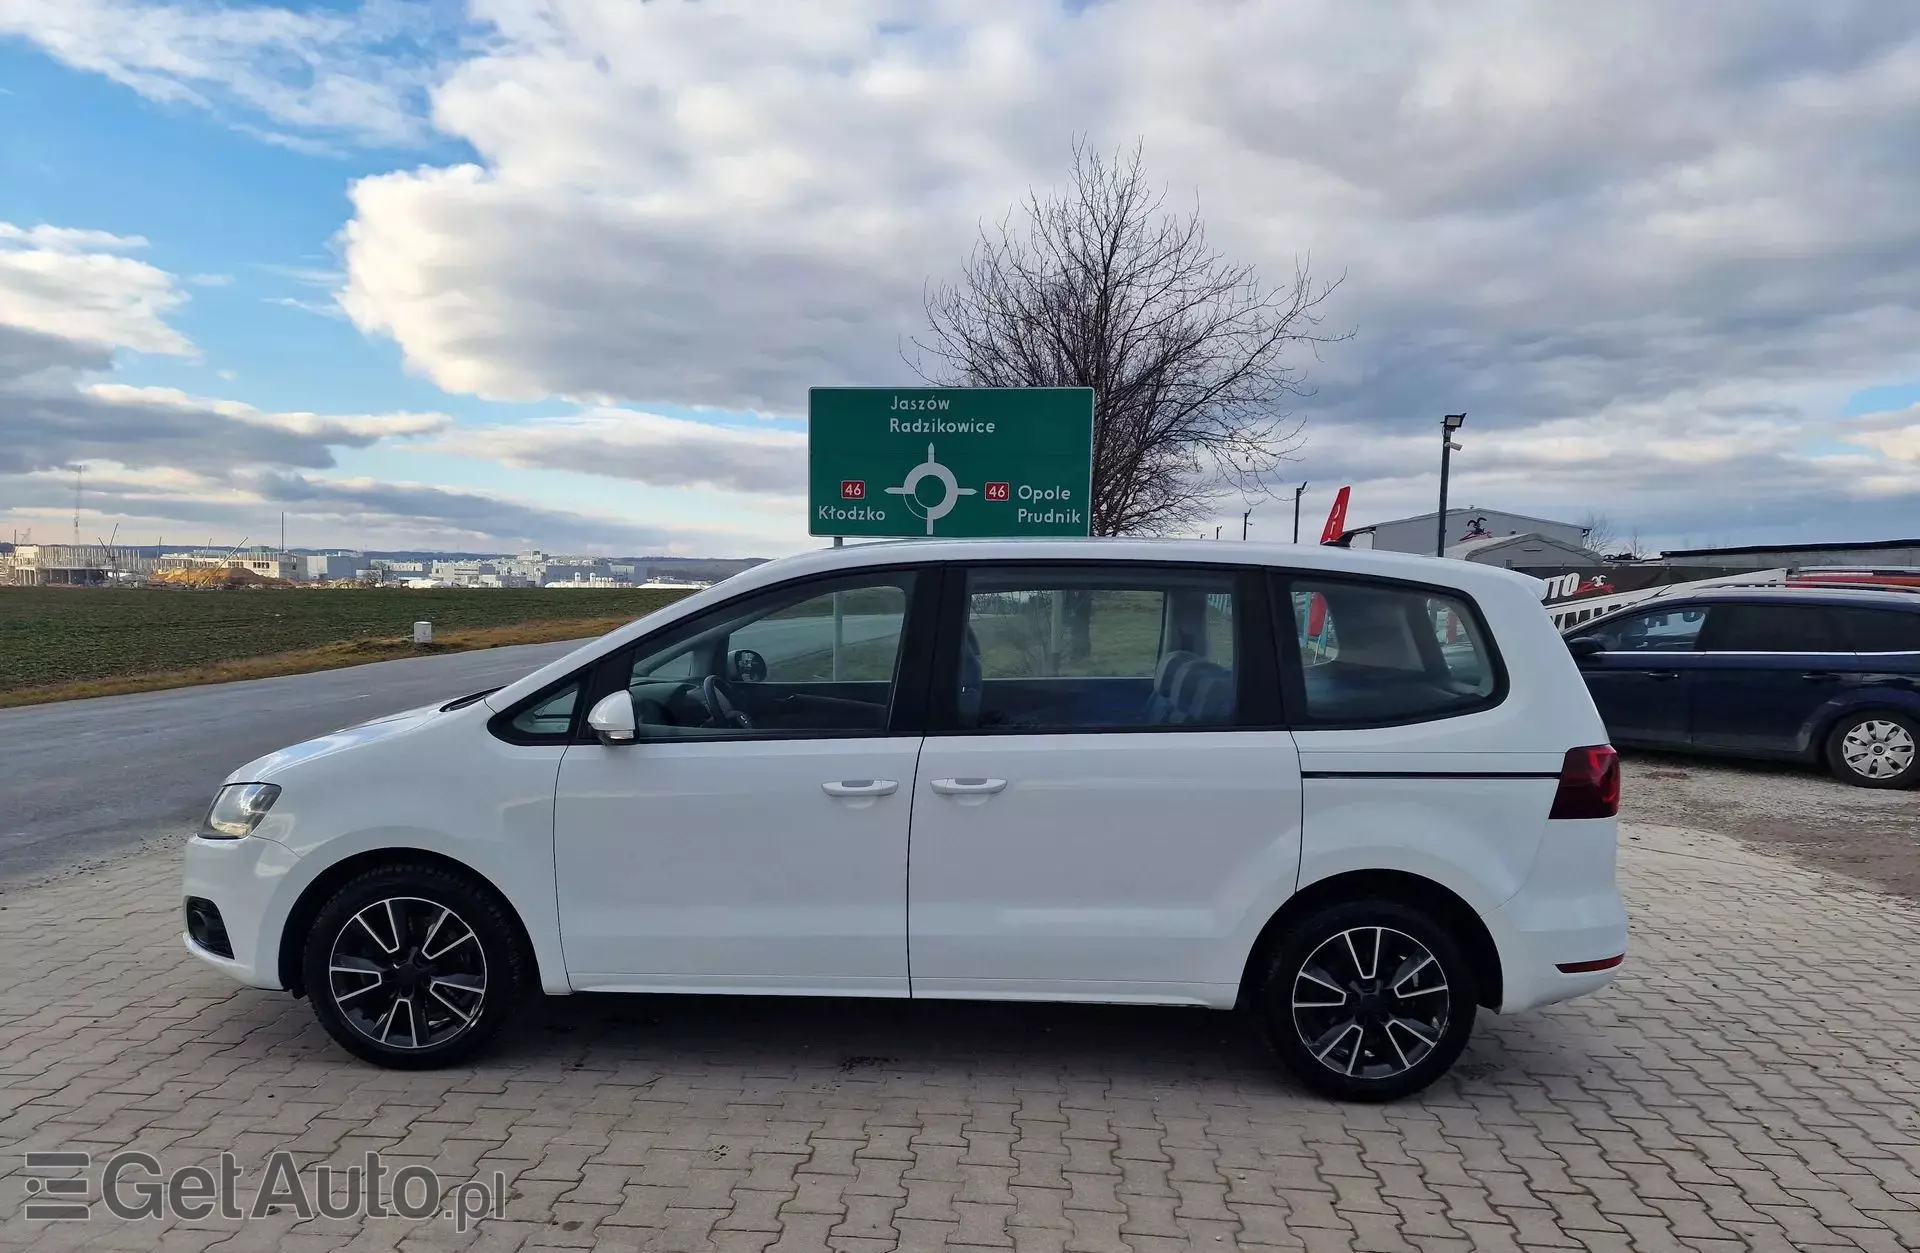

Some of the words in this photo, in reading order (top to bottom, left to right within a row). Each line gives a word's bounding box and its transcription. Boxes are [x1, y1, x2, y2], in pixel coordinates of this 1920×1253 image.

[890, 395, 950, 410] Jaszów
[889, 418, 996, 433] Radzikowice
[844, 483, 862, 496] 46
[988, 485, 1006, 498] 46
[1017, 485, 1071, 503] Opole
[818, 505, 886, 521] Kłodzko
[1017, 508, 1081, 524] Prudnik
